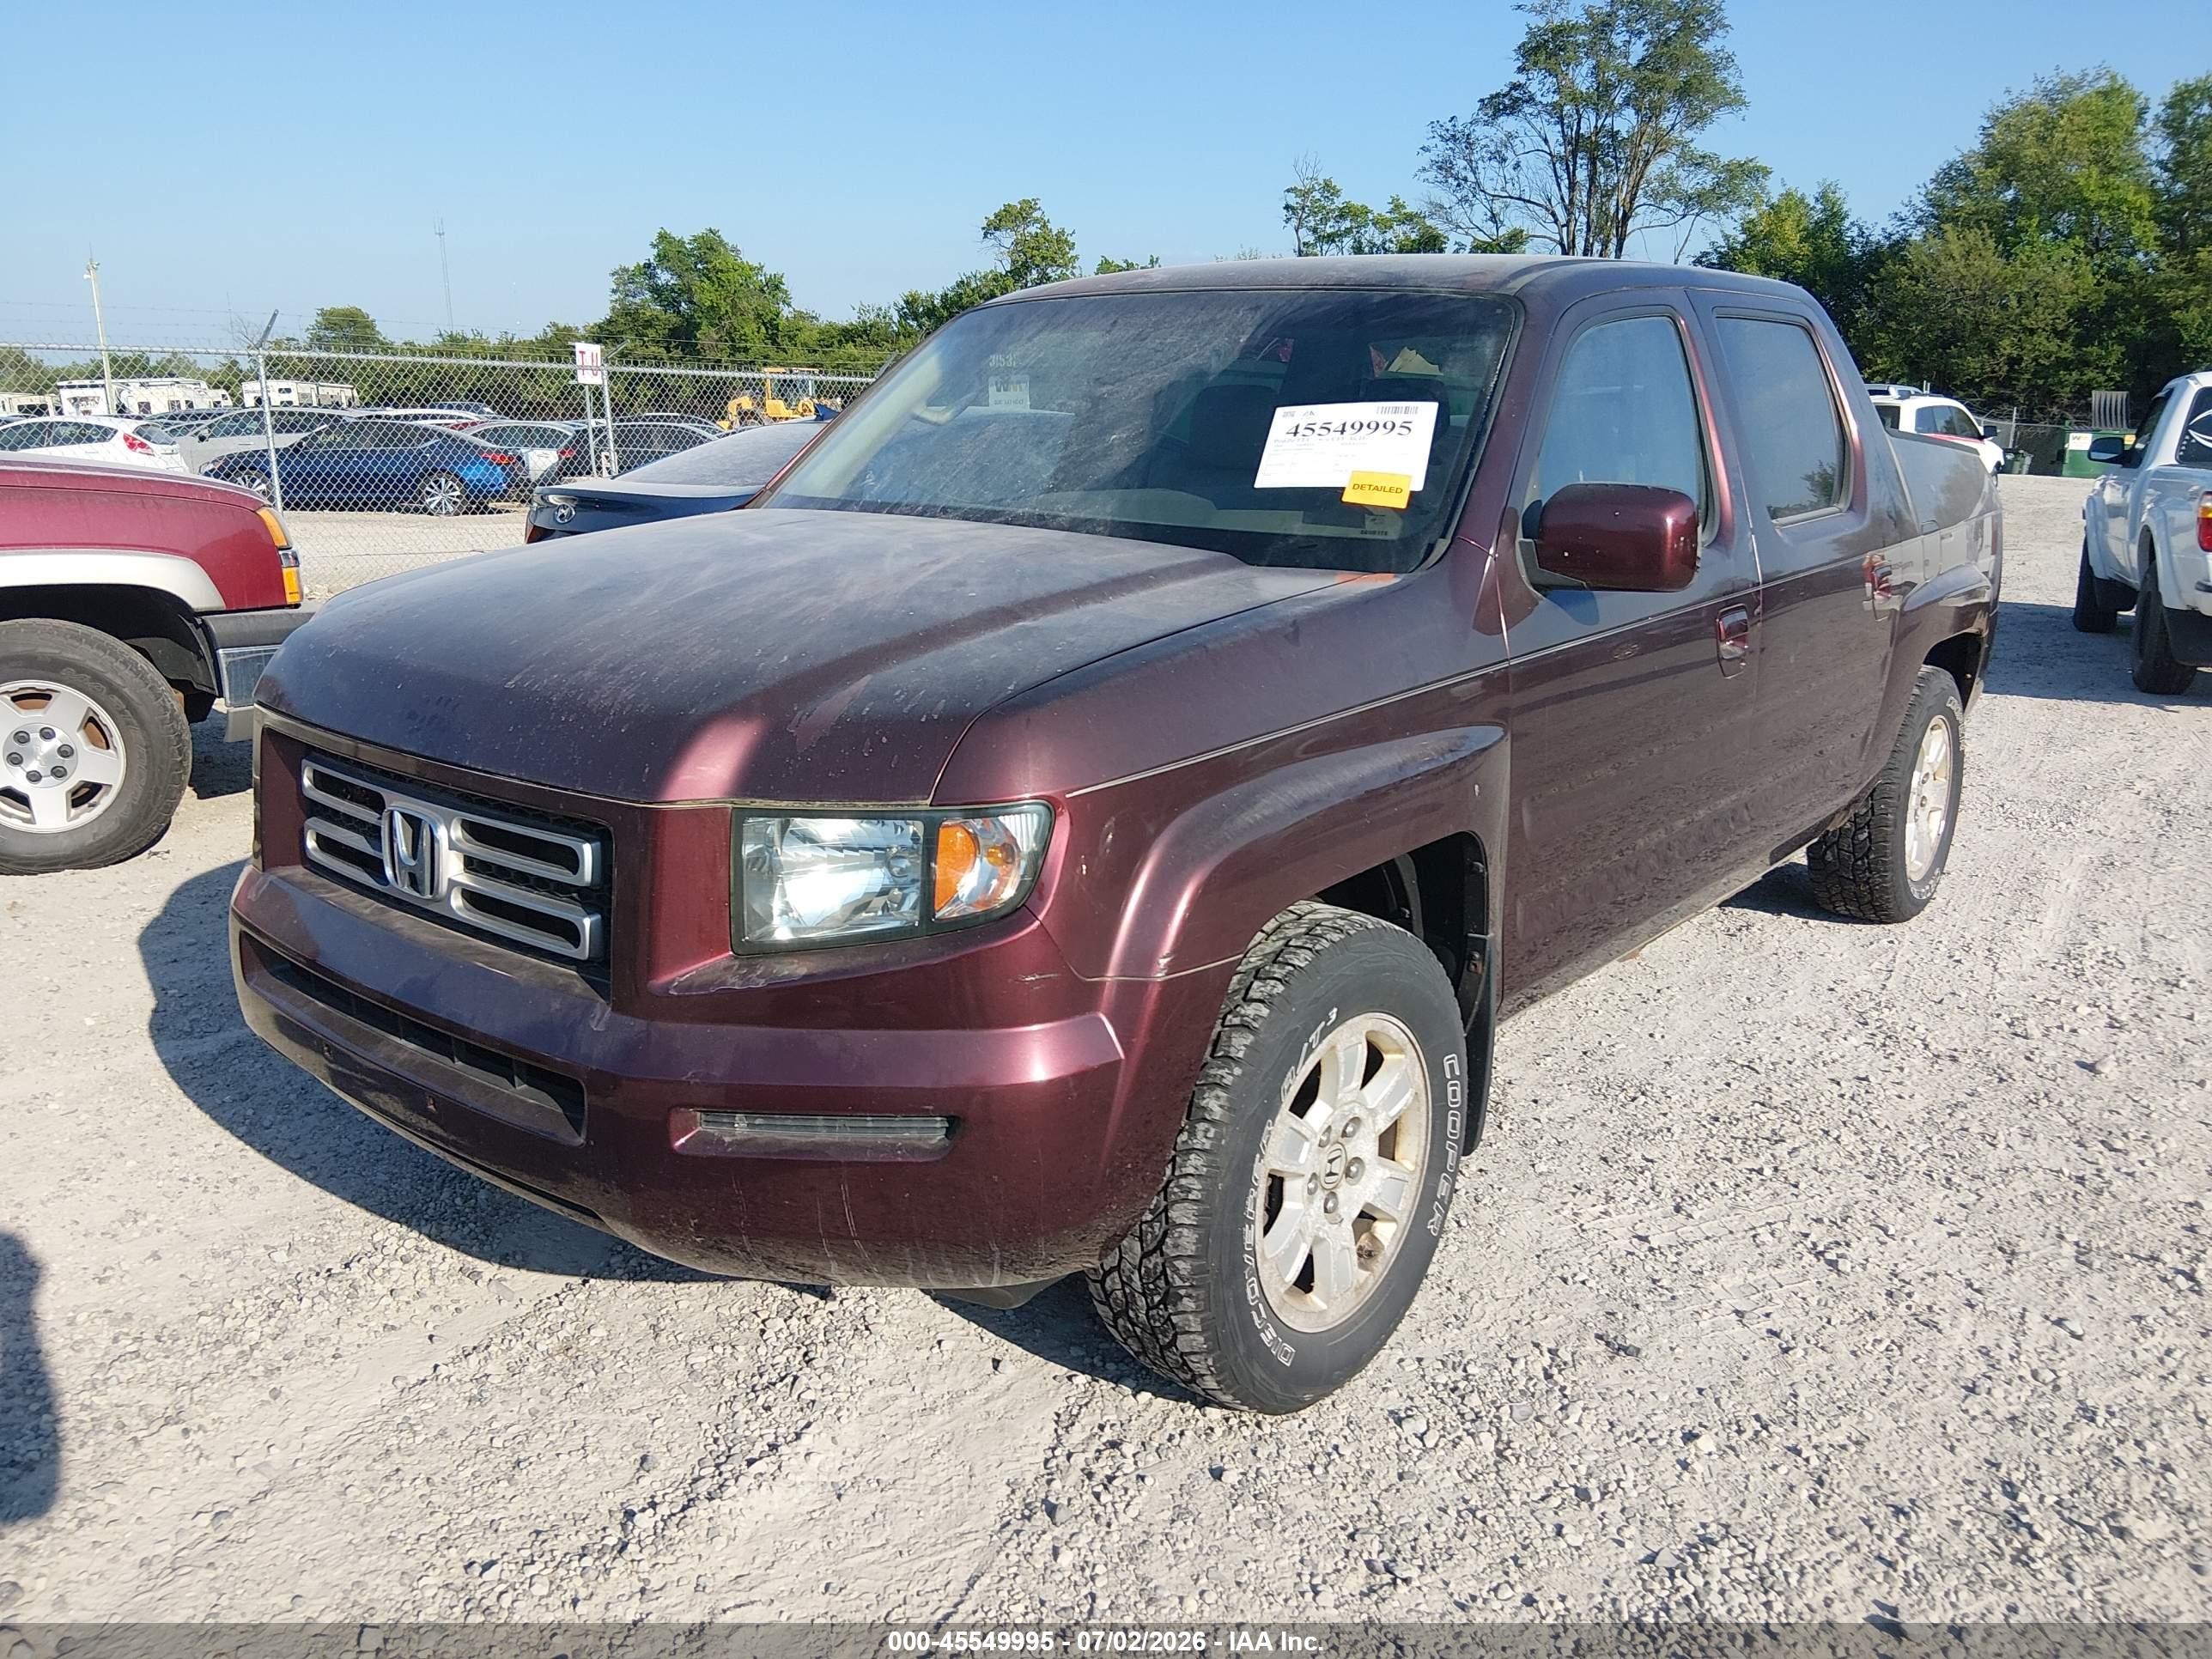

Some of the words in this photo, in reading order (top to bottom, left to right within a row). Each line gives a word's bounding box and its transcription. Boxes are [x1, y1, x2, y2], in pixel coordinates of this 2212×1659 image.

[1286, 420, 1413, 437] 45549995
[1352, 483, 1404, 495] DETAILED
[1426, 1053, 1461, 1237] COOPER
